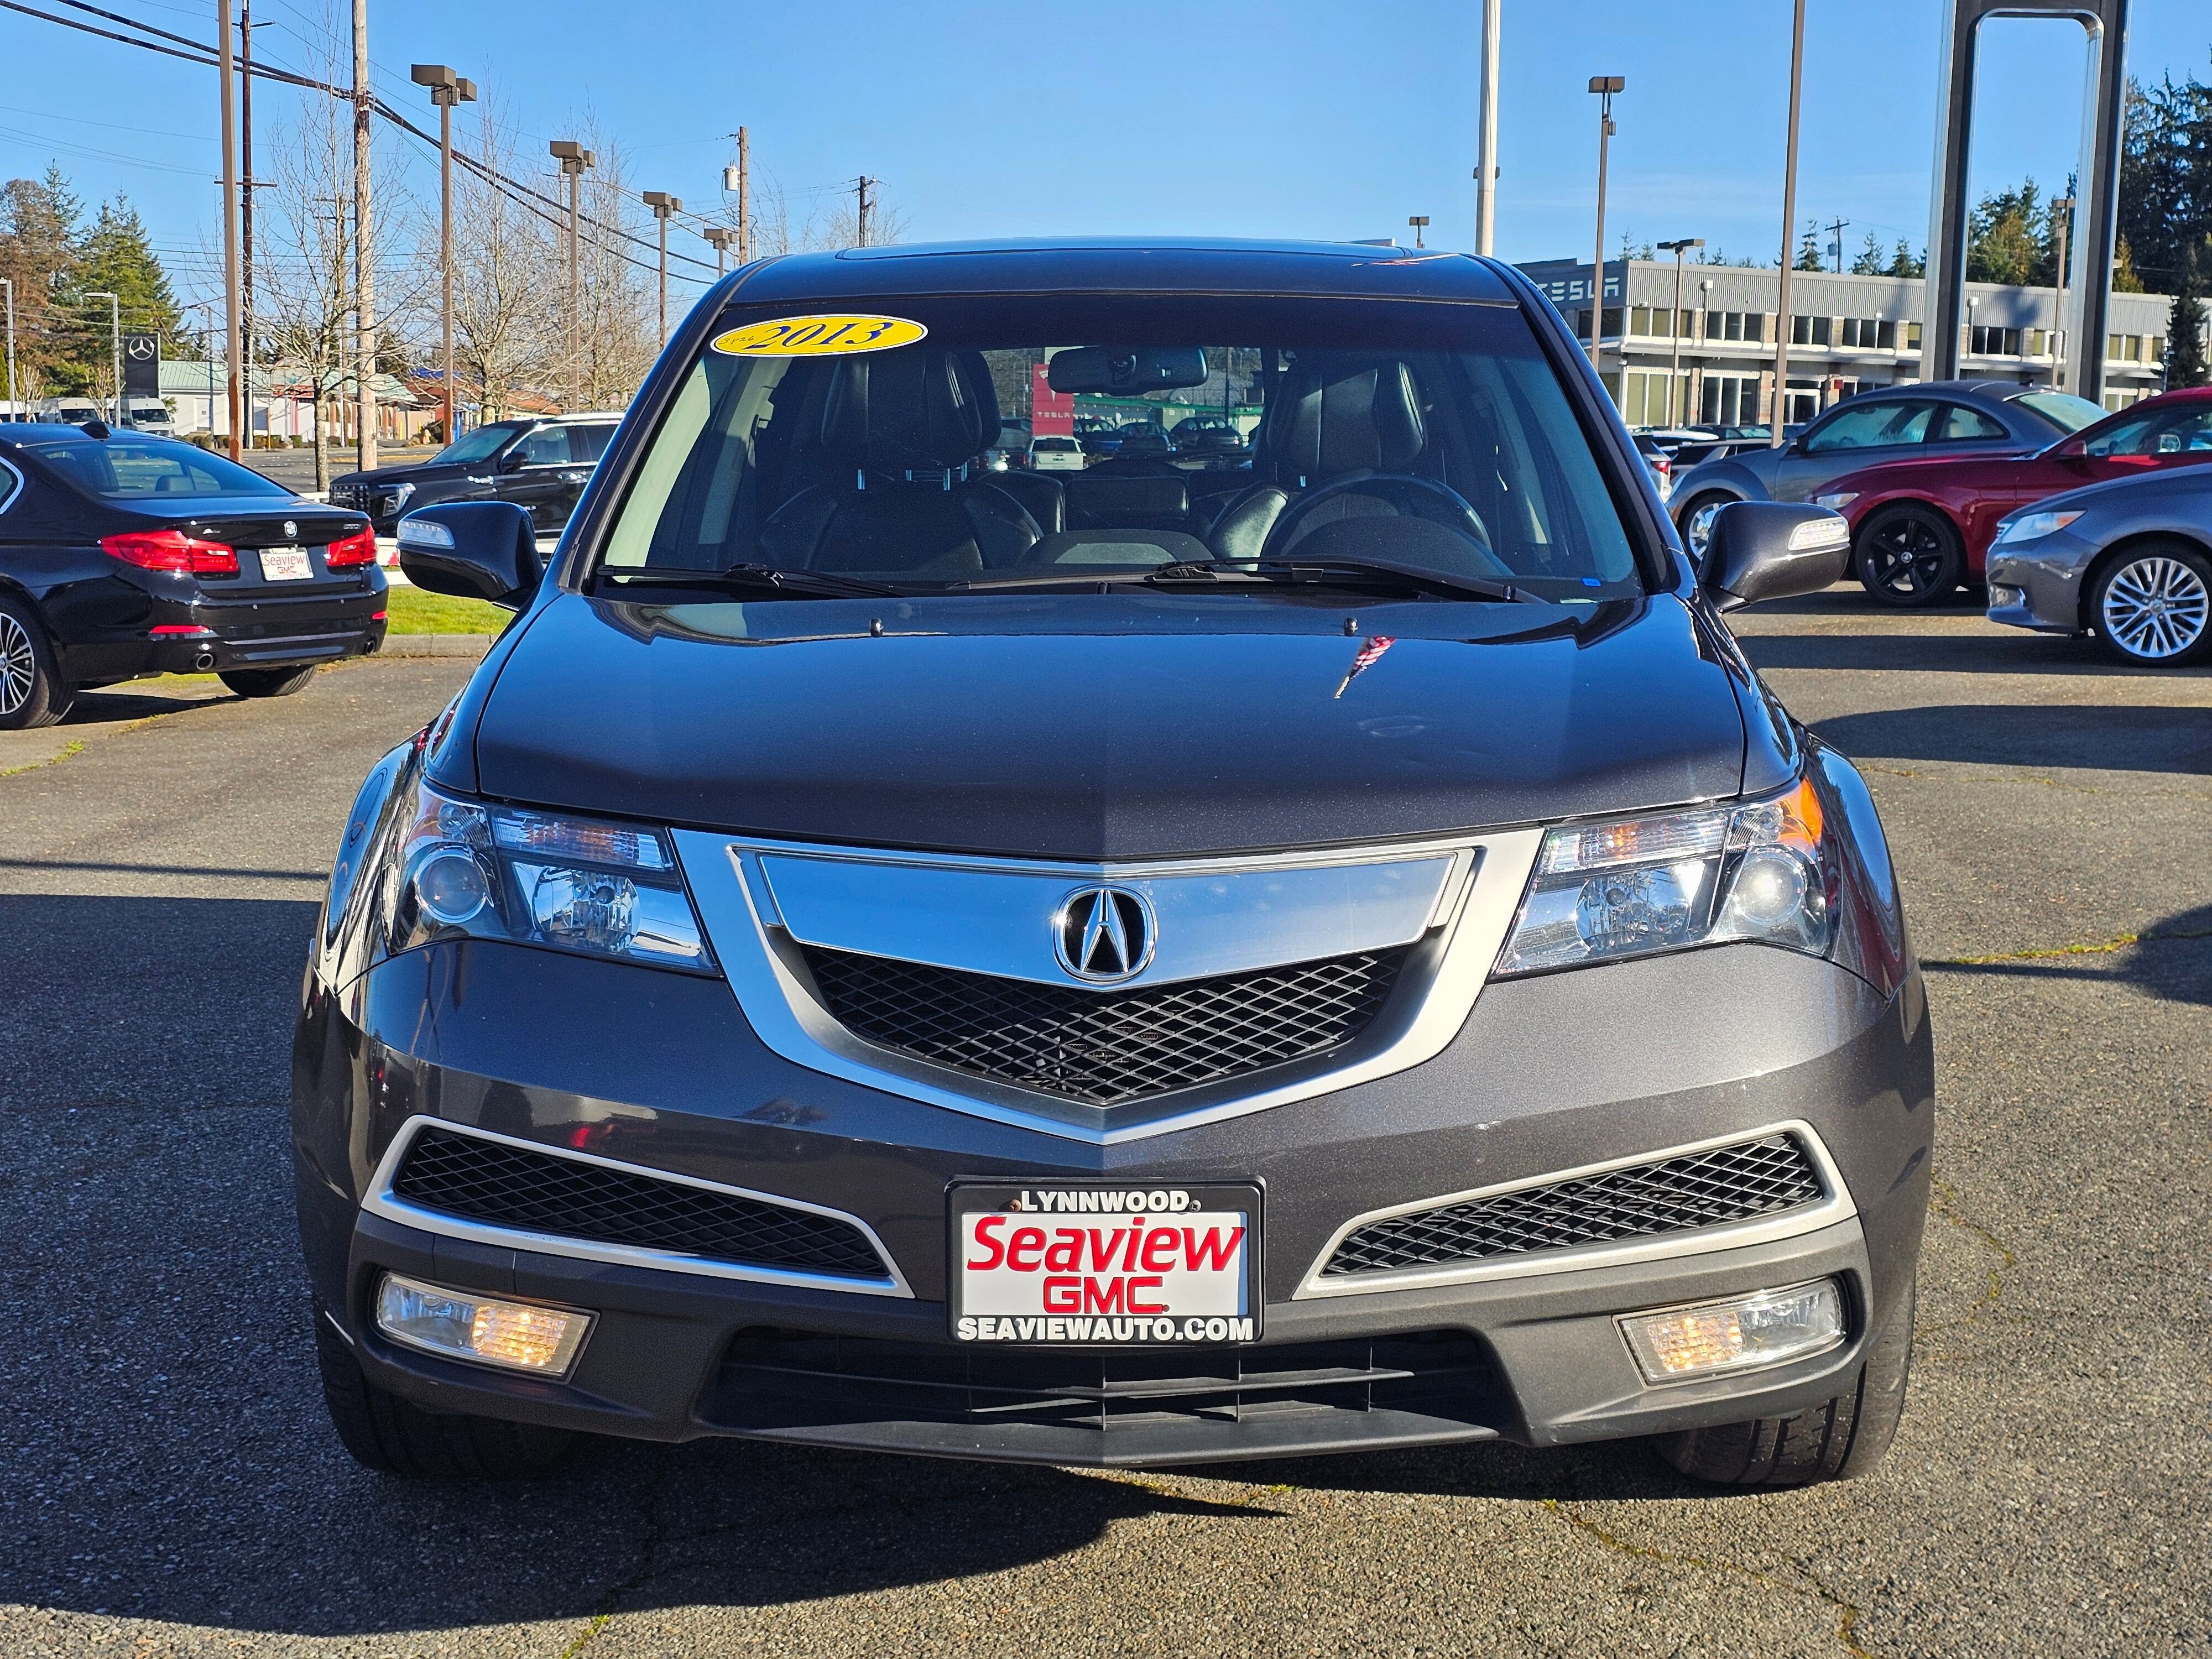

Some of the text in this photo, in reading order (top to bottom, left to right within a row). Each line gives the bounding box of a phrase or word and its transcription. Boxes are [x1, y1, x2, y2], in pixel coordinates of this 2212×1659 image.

[742, 322, 895, 350] 2013
[263, 555, 305, 566] Seaview
[277, 566, 297, 574] GMC
[1021, 1191, 1190, 1212] LYNNWOOD
[967, 1216, 1246, 1272] Seaview
[1043, 1276, 1164, 1314] GMC
[957, 1317, 1253, 1341] SEAVIEWAUTO.COM
